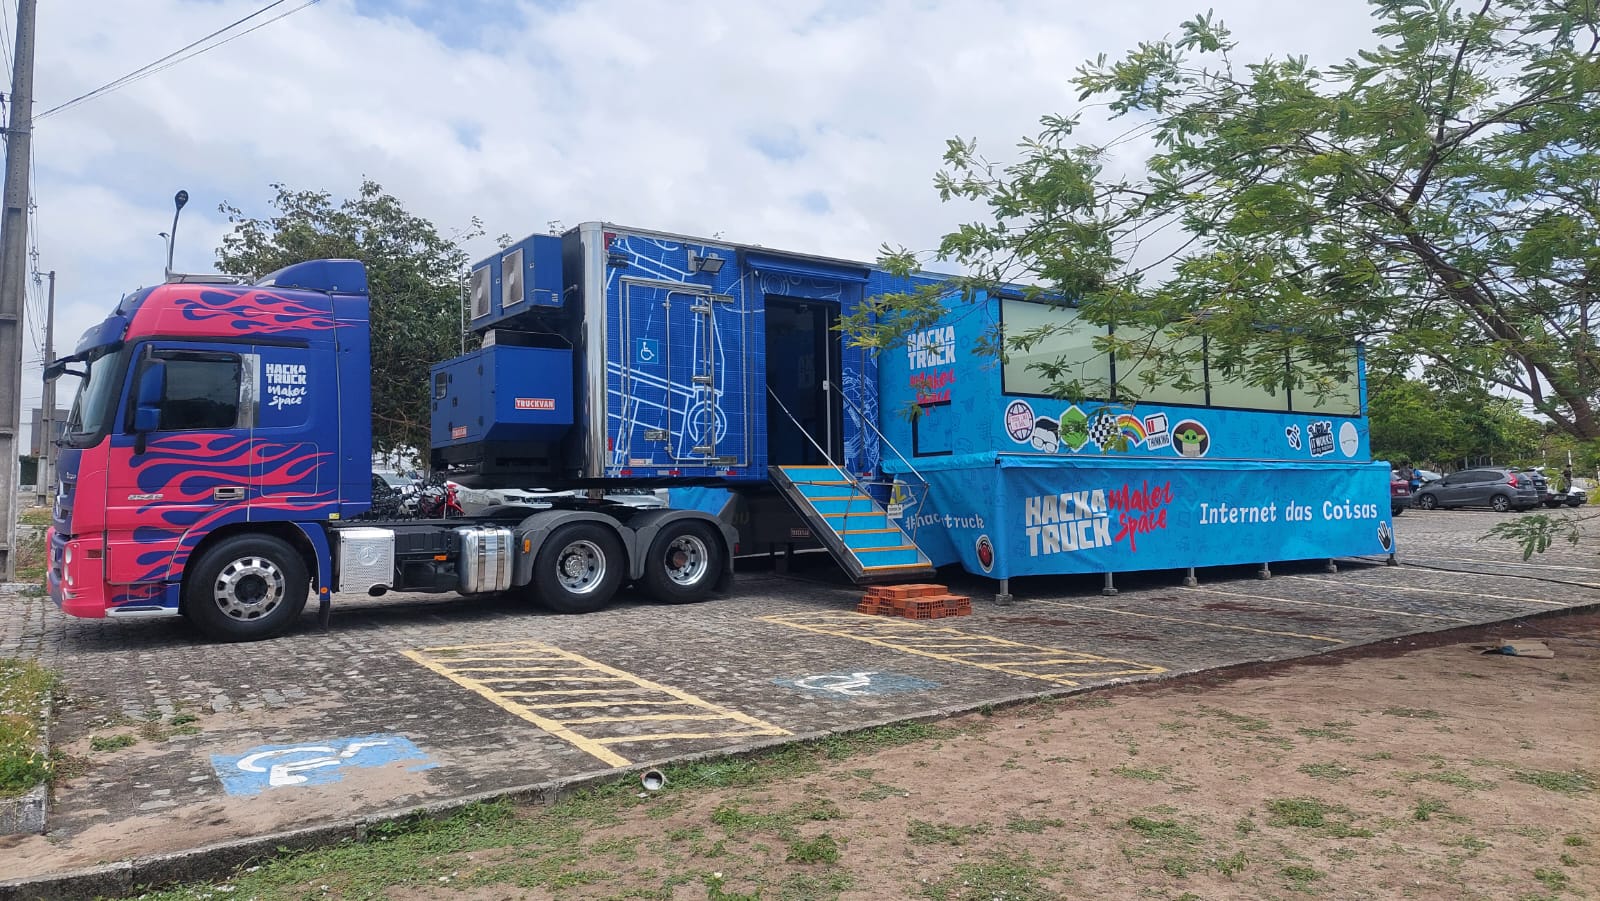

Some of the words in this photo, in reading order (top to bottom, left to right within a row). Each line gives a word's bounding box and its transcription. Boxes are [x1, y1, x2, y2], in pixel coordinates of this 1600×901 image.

[907, 325, 955, 353] HACKA
[265, 363, 307, 374] HACKA
[907, 343, 956, 370] TRUCK
[265, 373, 307, 385] TRUCK
[516, 399, 554, 408] TRUCKVAN
[1025, 489, 1107, 526] HACKA
[1199, 501, 1277, 525] Internet
[1285, 499, 1313, 522] das
[1322, 499, 1378, 521] Coisas
[1025, 517, 1113, 557] TRUCK
